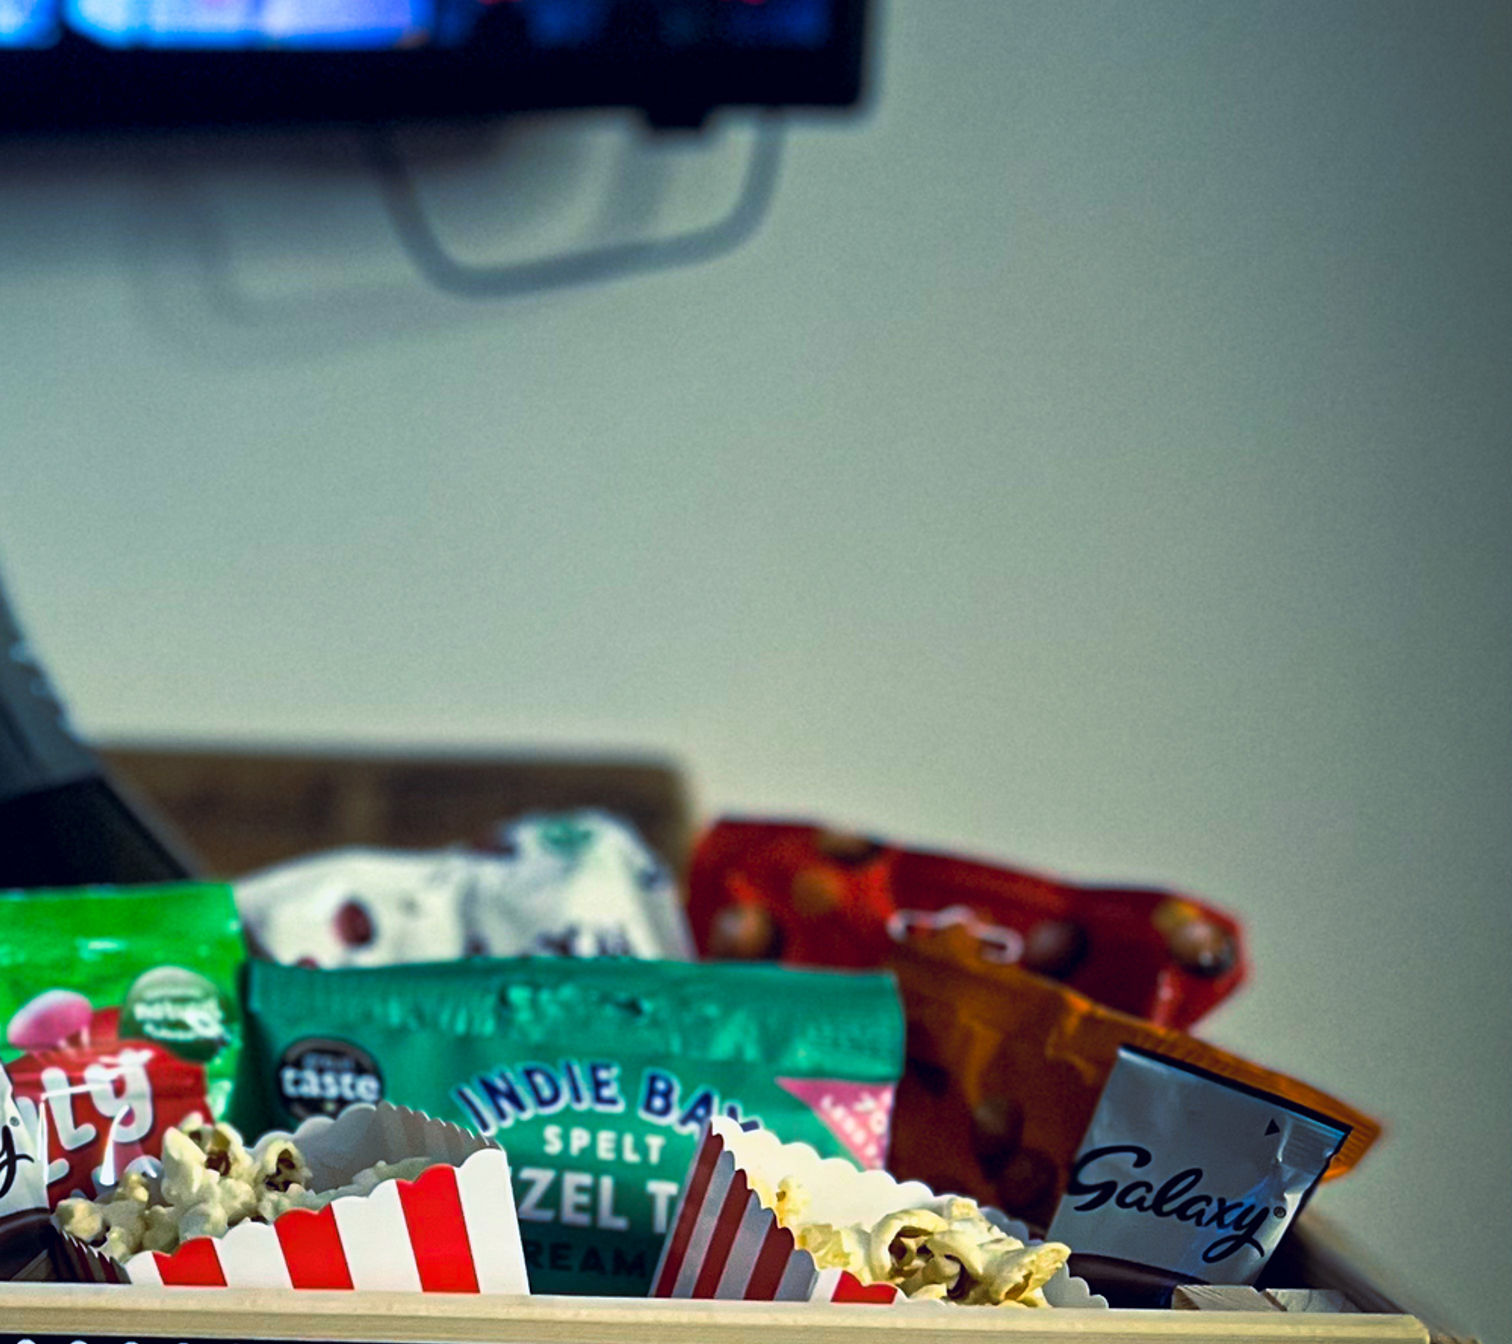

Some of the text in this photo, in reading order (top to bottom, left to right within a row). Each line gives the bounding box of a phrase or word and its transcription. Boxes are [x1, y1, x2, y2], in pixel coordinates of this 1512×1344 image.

[451, 1058, 625, 1136] INDIE
[543, 1124, 666, 1165] SPELT
[1067, 1145, 1269, 1264] Galaxy
